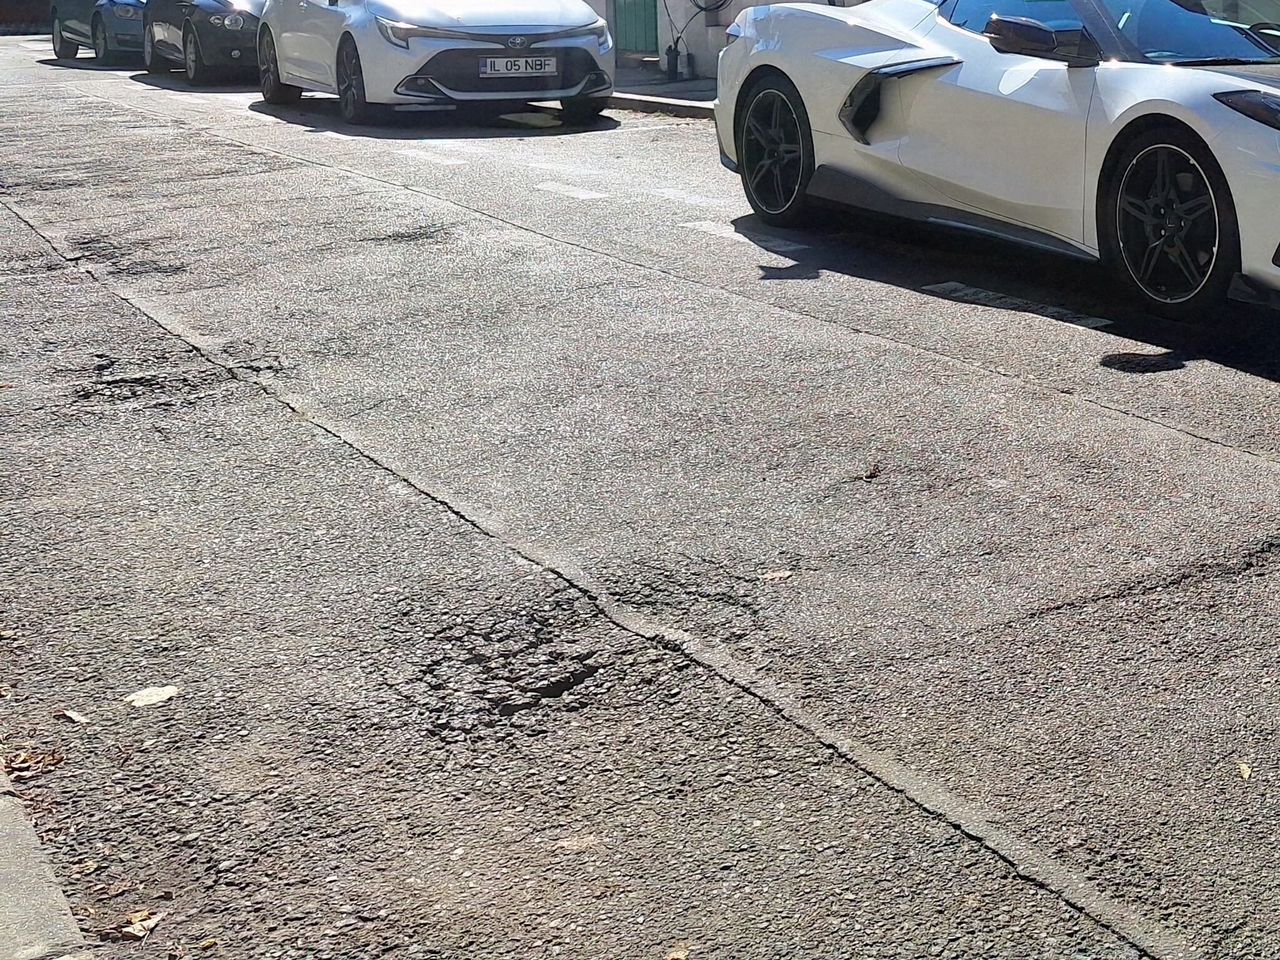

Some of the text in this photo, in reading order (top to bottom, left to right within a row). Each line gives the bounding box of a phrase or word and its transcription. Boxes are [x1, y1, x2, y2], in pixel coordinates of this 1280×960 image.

[490, 60, 500, 72] IL
[505, 60, 520, 71] 05
[524, 59, 552, 71] NBF
